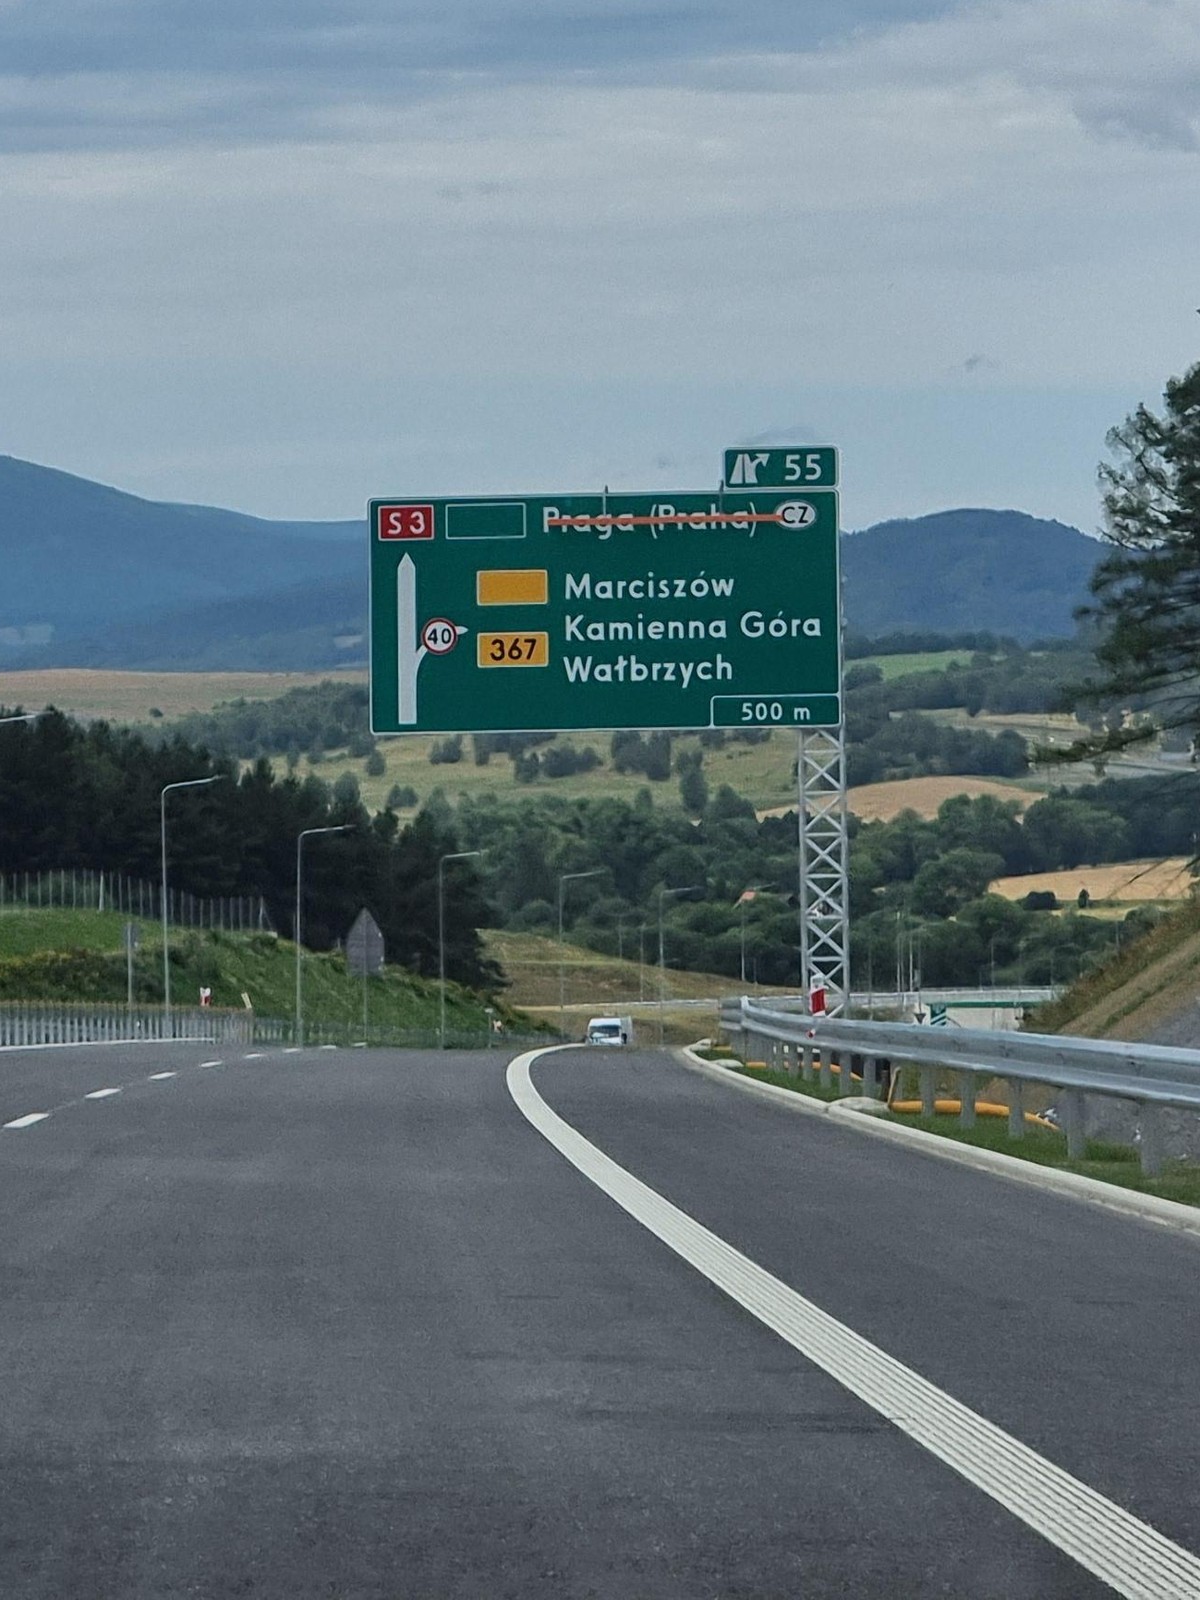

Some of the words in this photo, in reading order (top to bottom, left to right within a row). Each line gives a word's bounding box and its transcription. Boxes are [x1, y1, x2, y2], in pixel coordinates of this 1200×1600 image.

[784, 454, 822, 481] 55
[387, 512, 402, 535] S
[409, 511, 425, 534] 3
[543, 506, 635, 540] Praga
[651, 502, 757, 539] (Praha)
[781, 506, 809, 524] CZ
[565, 571, 735, 600] Marciszów
[427, 628, 452, 645] 40
[565, 613, 728, 642] Kamienna
[740, 610, 822, 638] Góra
[489, 638, 537, 661] 367
[563, 653, 733, 689] Wałbrzych
[741, 702, 783, 721] 500
[793, 706, 811, 720] m
